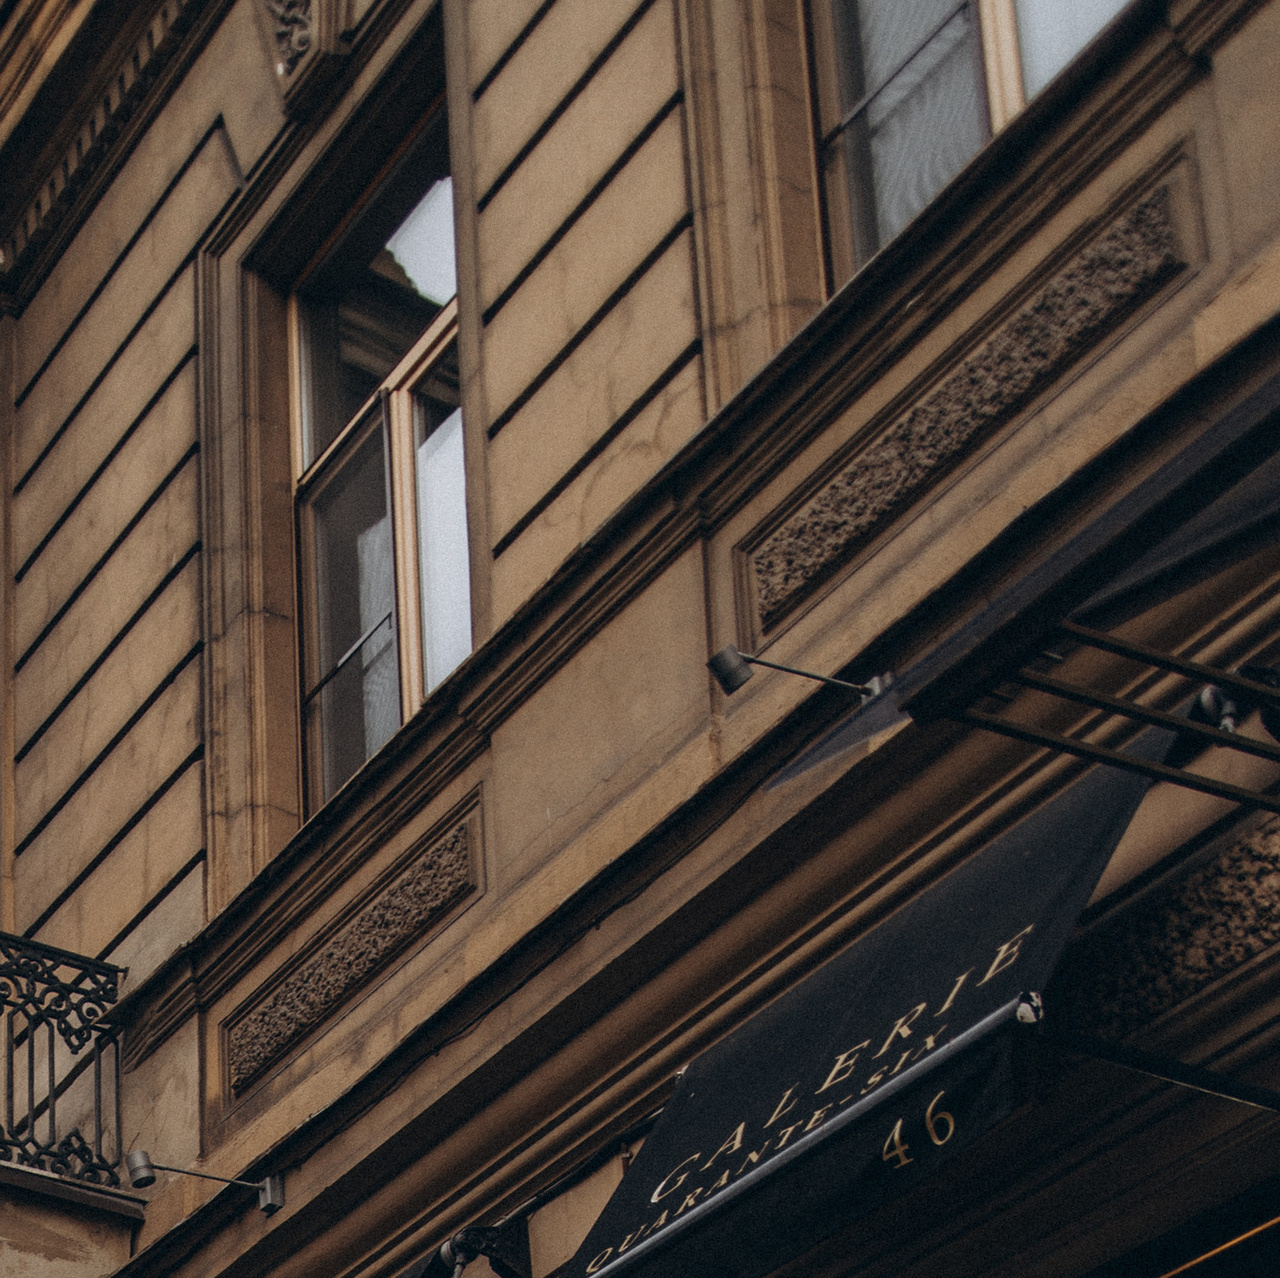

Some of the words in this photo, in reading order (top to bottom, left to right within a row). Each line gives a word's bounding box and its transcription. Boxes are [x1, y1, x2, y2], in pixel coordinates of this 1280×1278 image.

[584, 1023, 951, 1274] QUARANTE-SIX
[650, 922, 1035, 1204] GALERIE
[881, 1089, 956, 1170] 46
